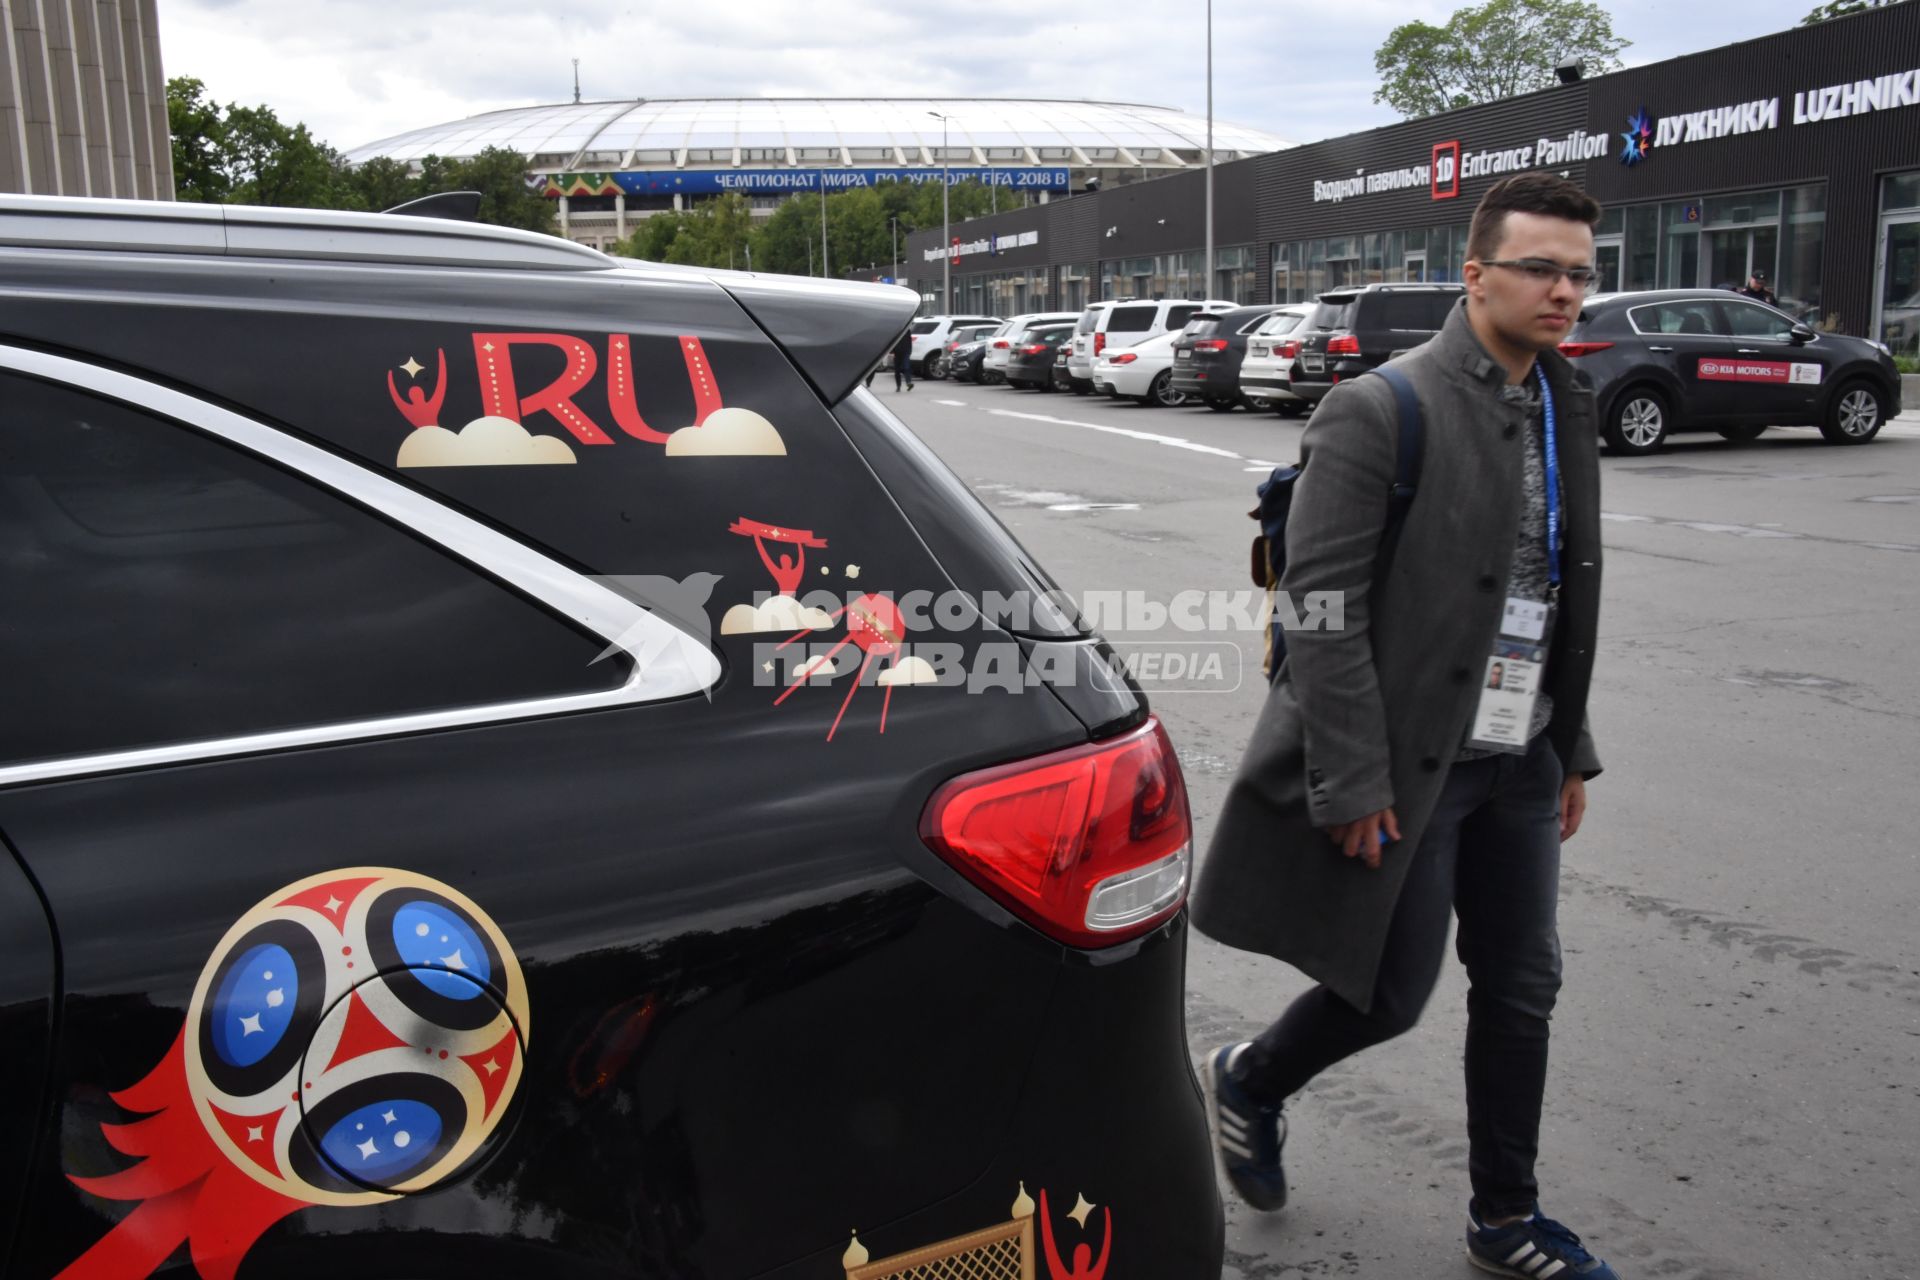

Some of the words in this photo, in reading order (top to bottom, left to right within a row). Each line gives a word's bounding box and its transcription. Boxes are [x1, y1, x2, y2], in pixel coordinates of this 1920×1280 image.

[1793, 68, 1920, 125] LUZHNIKI
[1653, 97, 1780, 148] ЛУЖНИКИ
[1435, 156, 1453, 183] 1D
[1459, 144, 1532, 178] Entrance
[1535, 129, 1609, 166] Pavilion
[715, 173, 816, 188] ЧЕМПИОНАТ
[822, 173, 868, 187] МИРА
[982, 172, 1014, 186] FIFA
[1017, 172, 1051, 186] 2018
[1055, 172, 1066, 186] В
[1313, 168, 1364, 203] Входной
[1366, 164, 1431, 194] павильон
[1719, 365, 1735, 375] KIA
[1736, 365, 1772, 376] MOTORS
